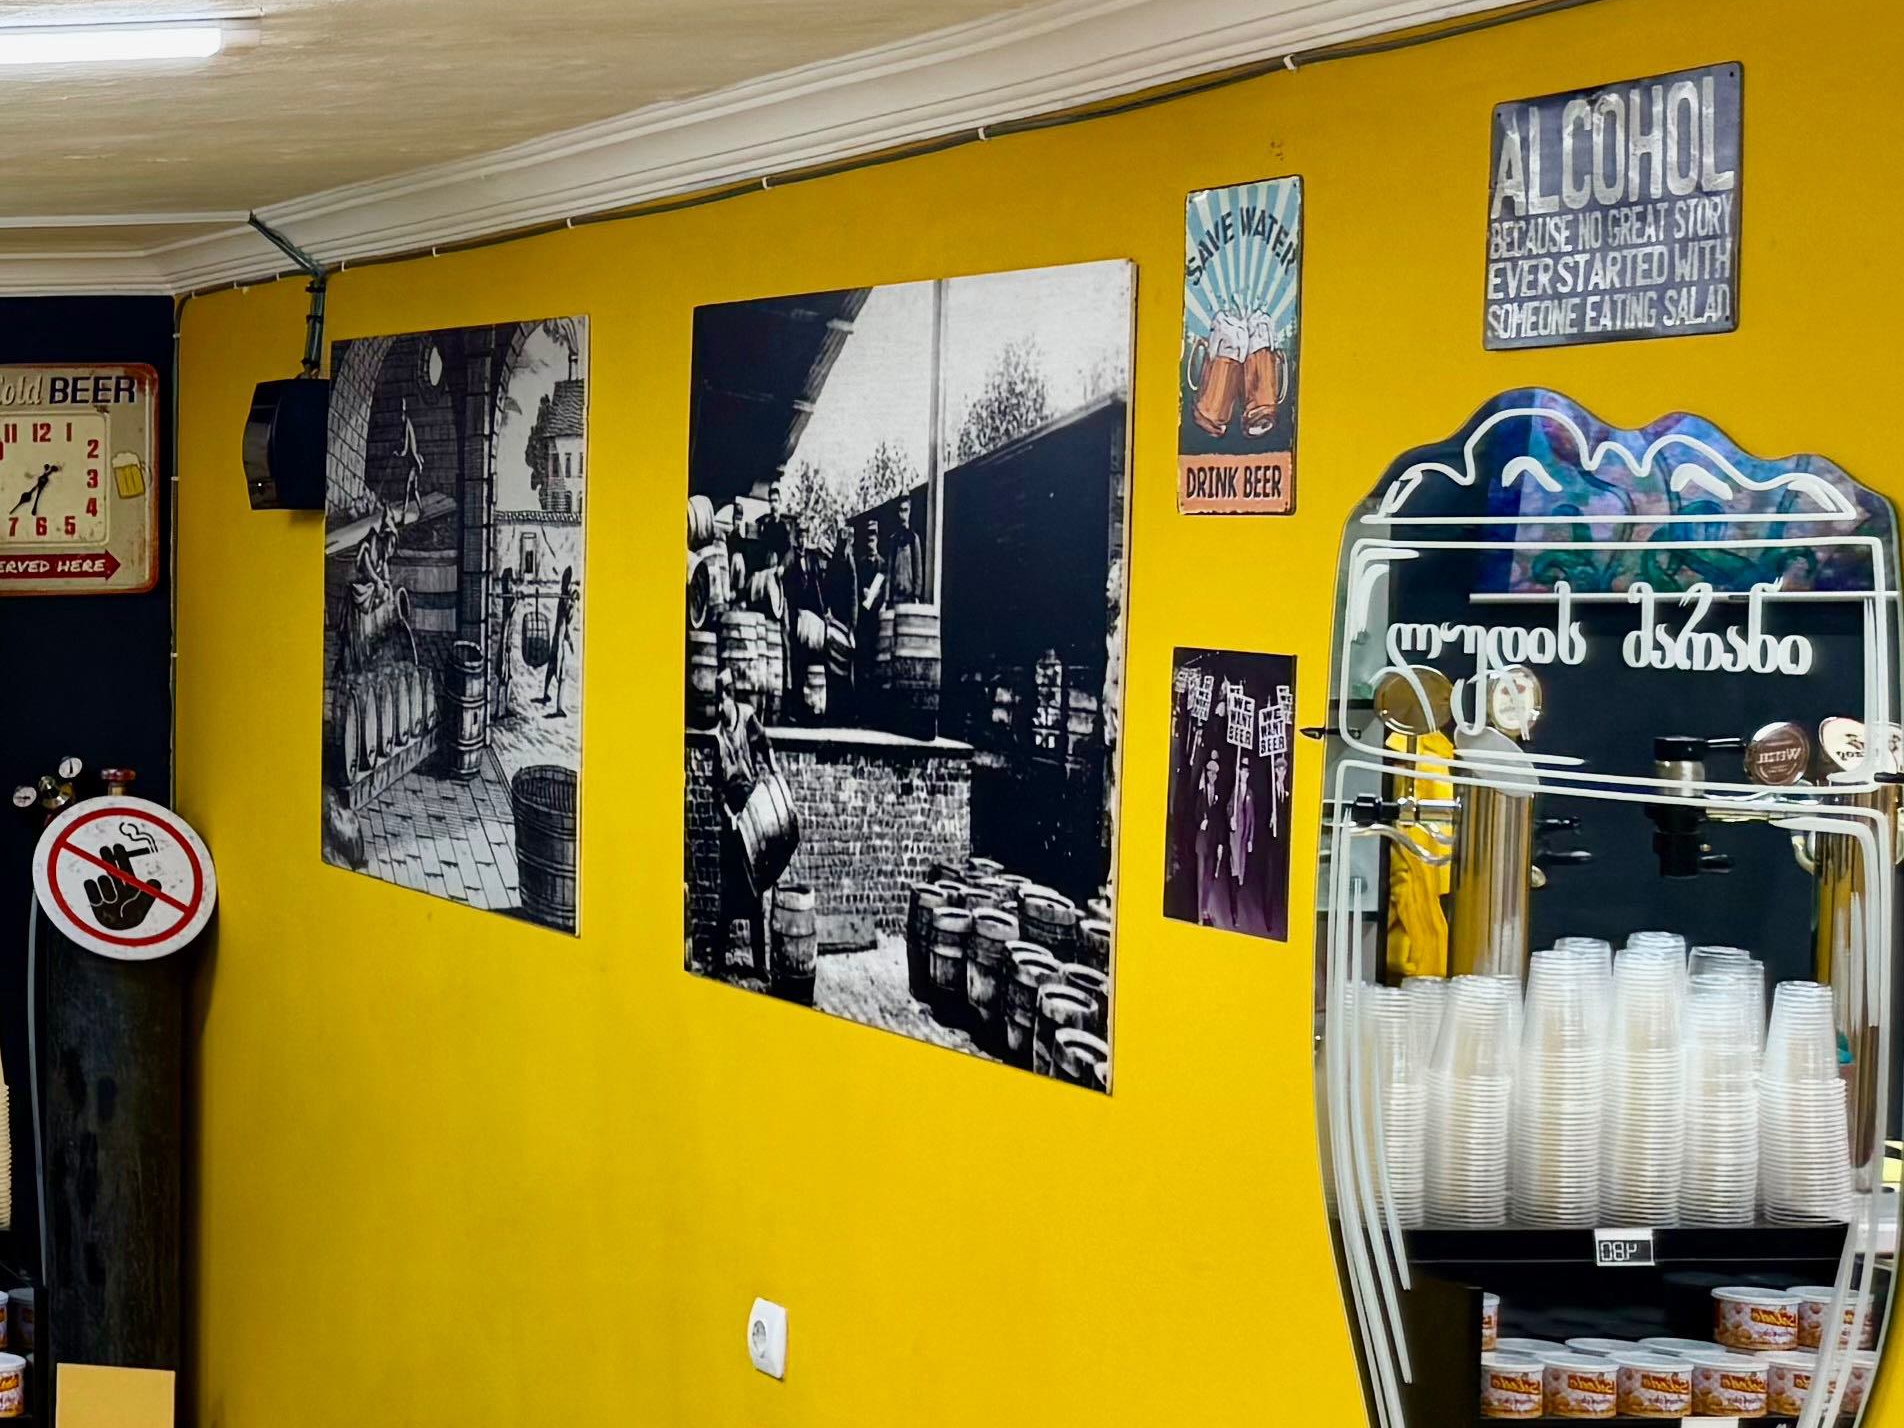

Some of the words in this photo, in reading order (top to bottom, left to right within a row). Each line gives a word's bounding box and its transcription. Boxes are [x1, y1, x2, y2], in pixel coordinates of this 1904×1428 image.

[1491, 76, 1734, 219] ALCOHOL
[1490, 215, 1573, 259] BECAUSE
[1579, 211, 1602, 249] NO
[1608, 202, 1668, 247] GREAT
[1674, 194, 1734, 238] STORY
[1186, 211, 1234, 286] SAVE
[1240, 205, 1297, 275] WATER
[1488, 258, 1553, 300] EVER
[1556, 245, 1668, 294] STARTED
[1674, 238, 1732, 282] WITH
[1488, 297, 1579, 339] SOMEONE
[1585, 291, 1657, 332] EATING
[1663, 284, 1730, 326] SALAD
[49, 376, 135, 404] BEER
[4, 423, 17, 443] 11
[32, 423, 51, 442] 12
[66, 423, 72, 442] 1
[87, 439, 99, 459] 2
[87, 469, 99, 489] 3
[1186, 466, 1239, 499] DRINK
[1243, 464, 1282, 499] BEER
[86, 497, 98, 517] 4
[9, 517, 19, 537] 7
[36, 517, 47, 536] 6
[65, 516, 76, 535] 5
[57, 559, 105, 573] HERE
[1372, 580, 1586, 740] ლუდის
[1623, 577, 1814, 675] მარანი
